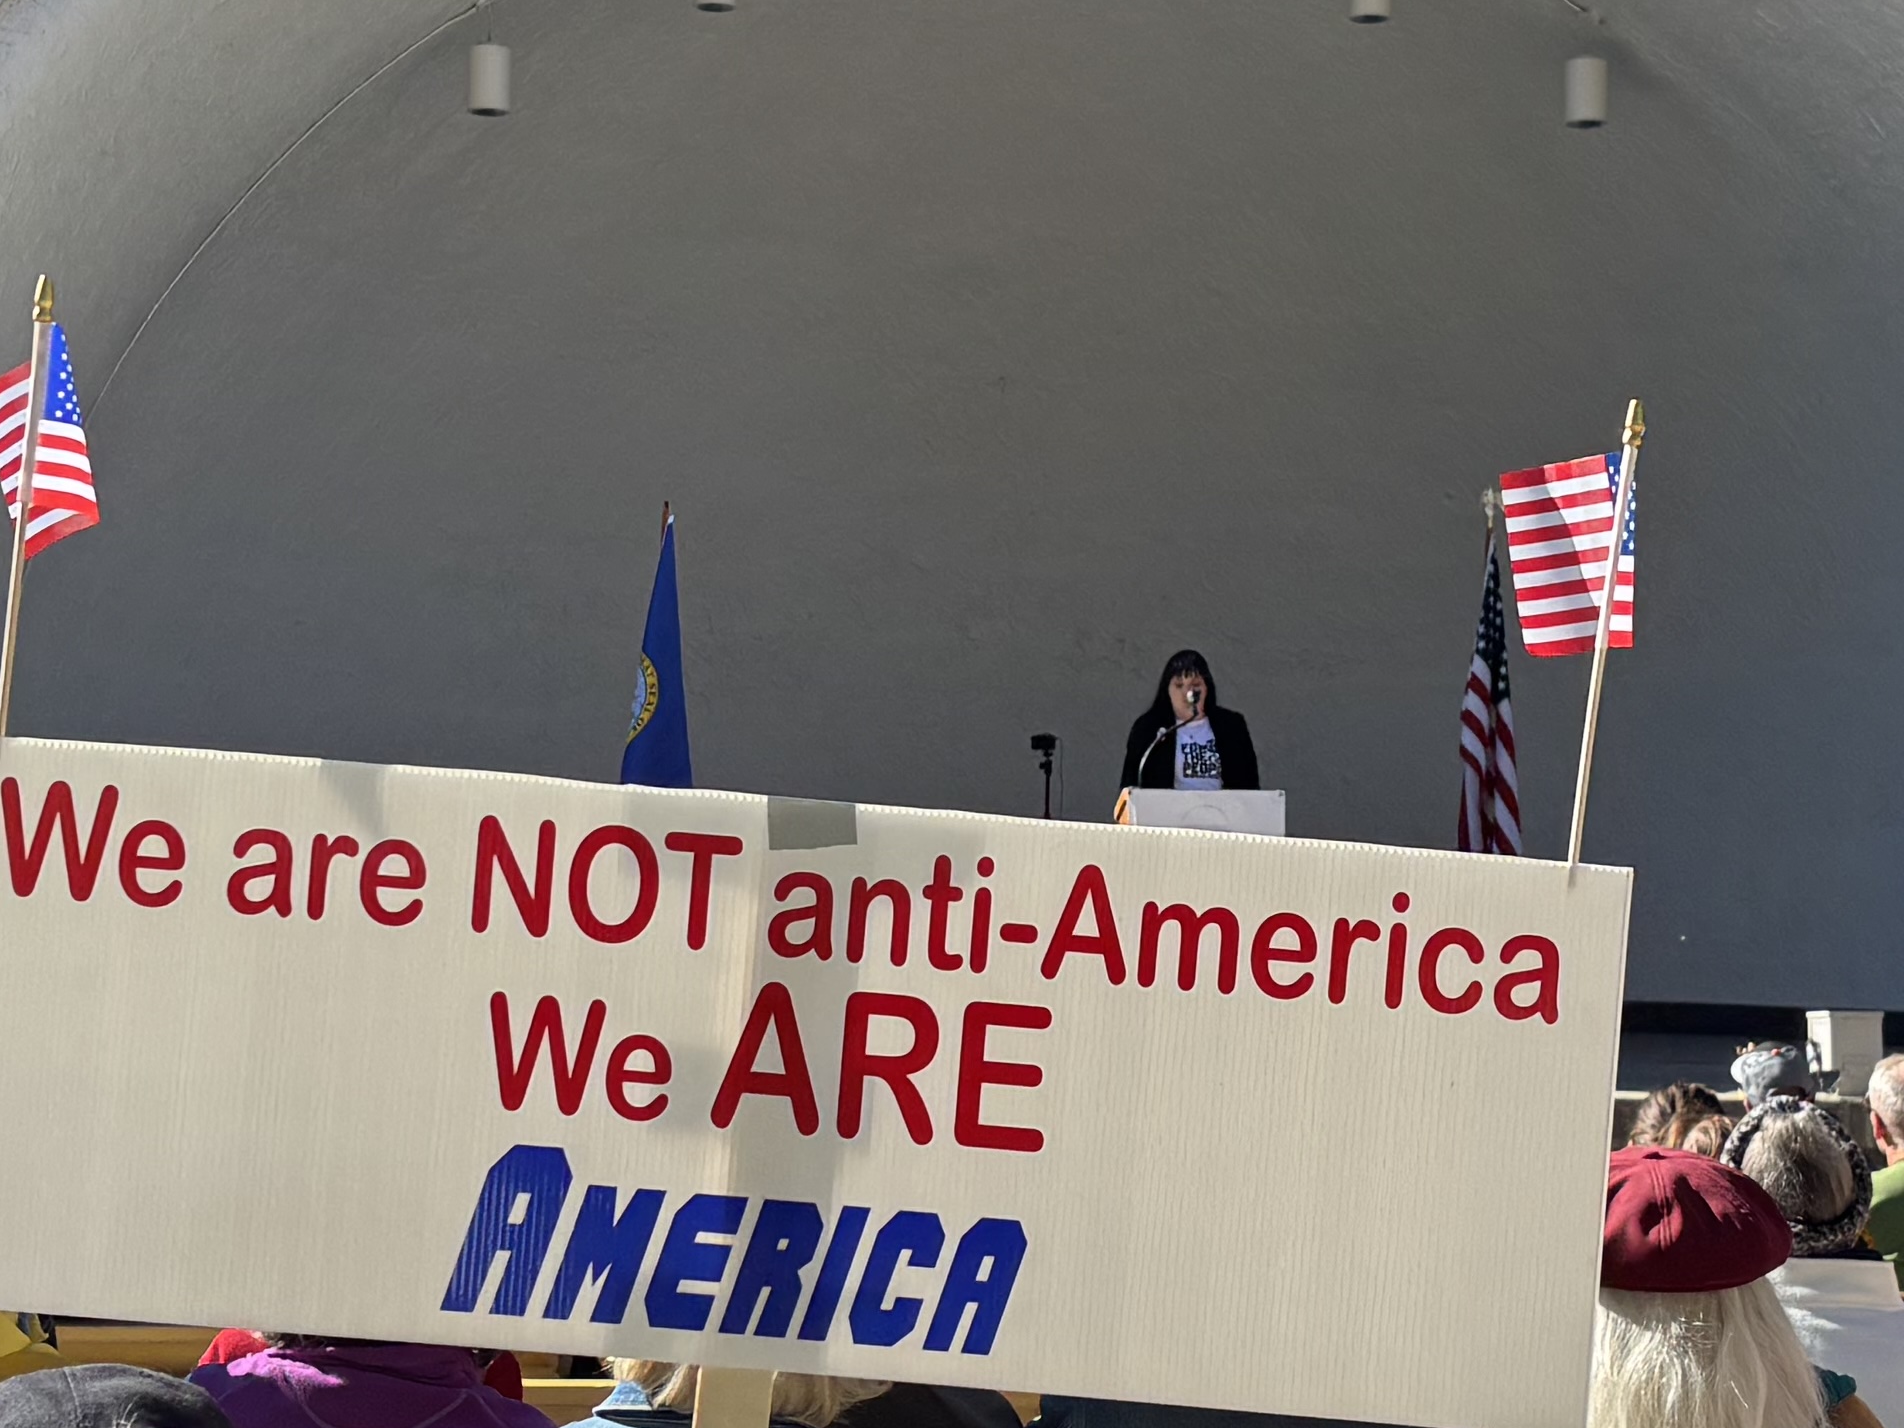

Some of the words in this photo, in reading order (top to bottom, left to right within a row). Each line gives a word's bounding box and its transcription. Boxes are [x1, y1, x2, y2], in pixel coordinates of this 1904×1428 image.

[0, 776, 186, 909] We
[226, 827, 428, 927] are
[470, 813, 744, 952] NOT
[767, 853, 1561, 1026] anti-America
[489, 990, 673, 1123] We
[709, 981, 1054, 1153] ARE
[439, 1143, 1029, 1356] AMERICA
